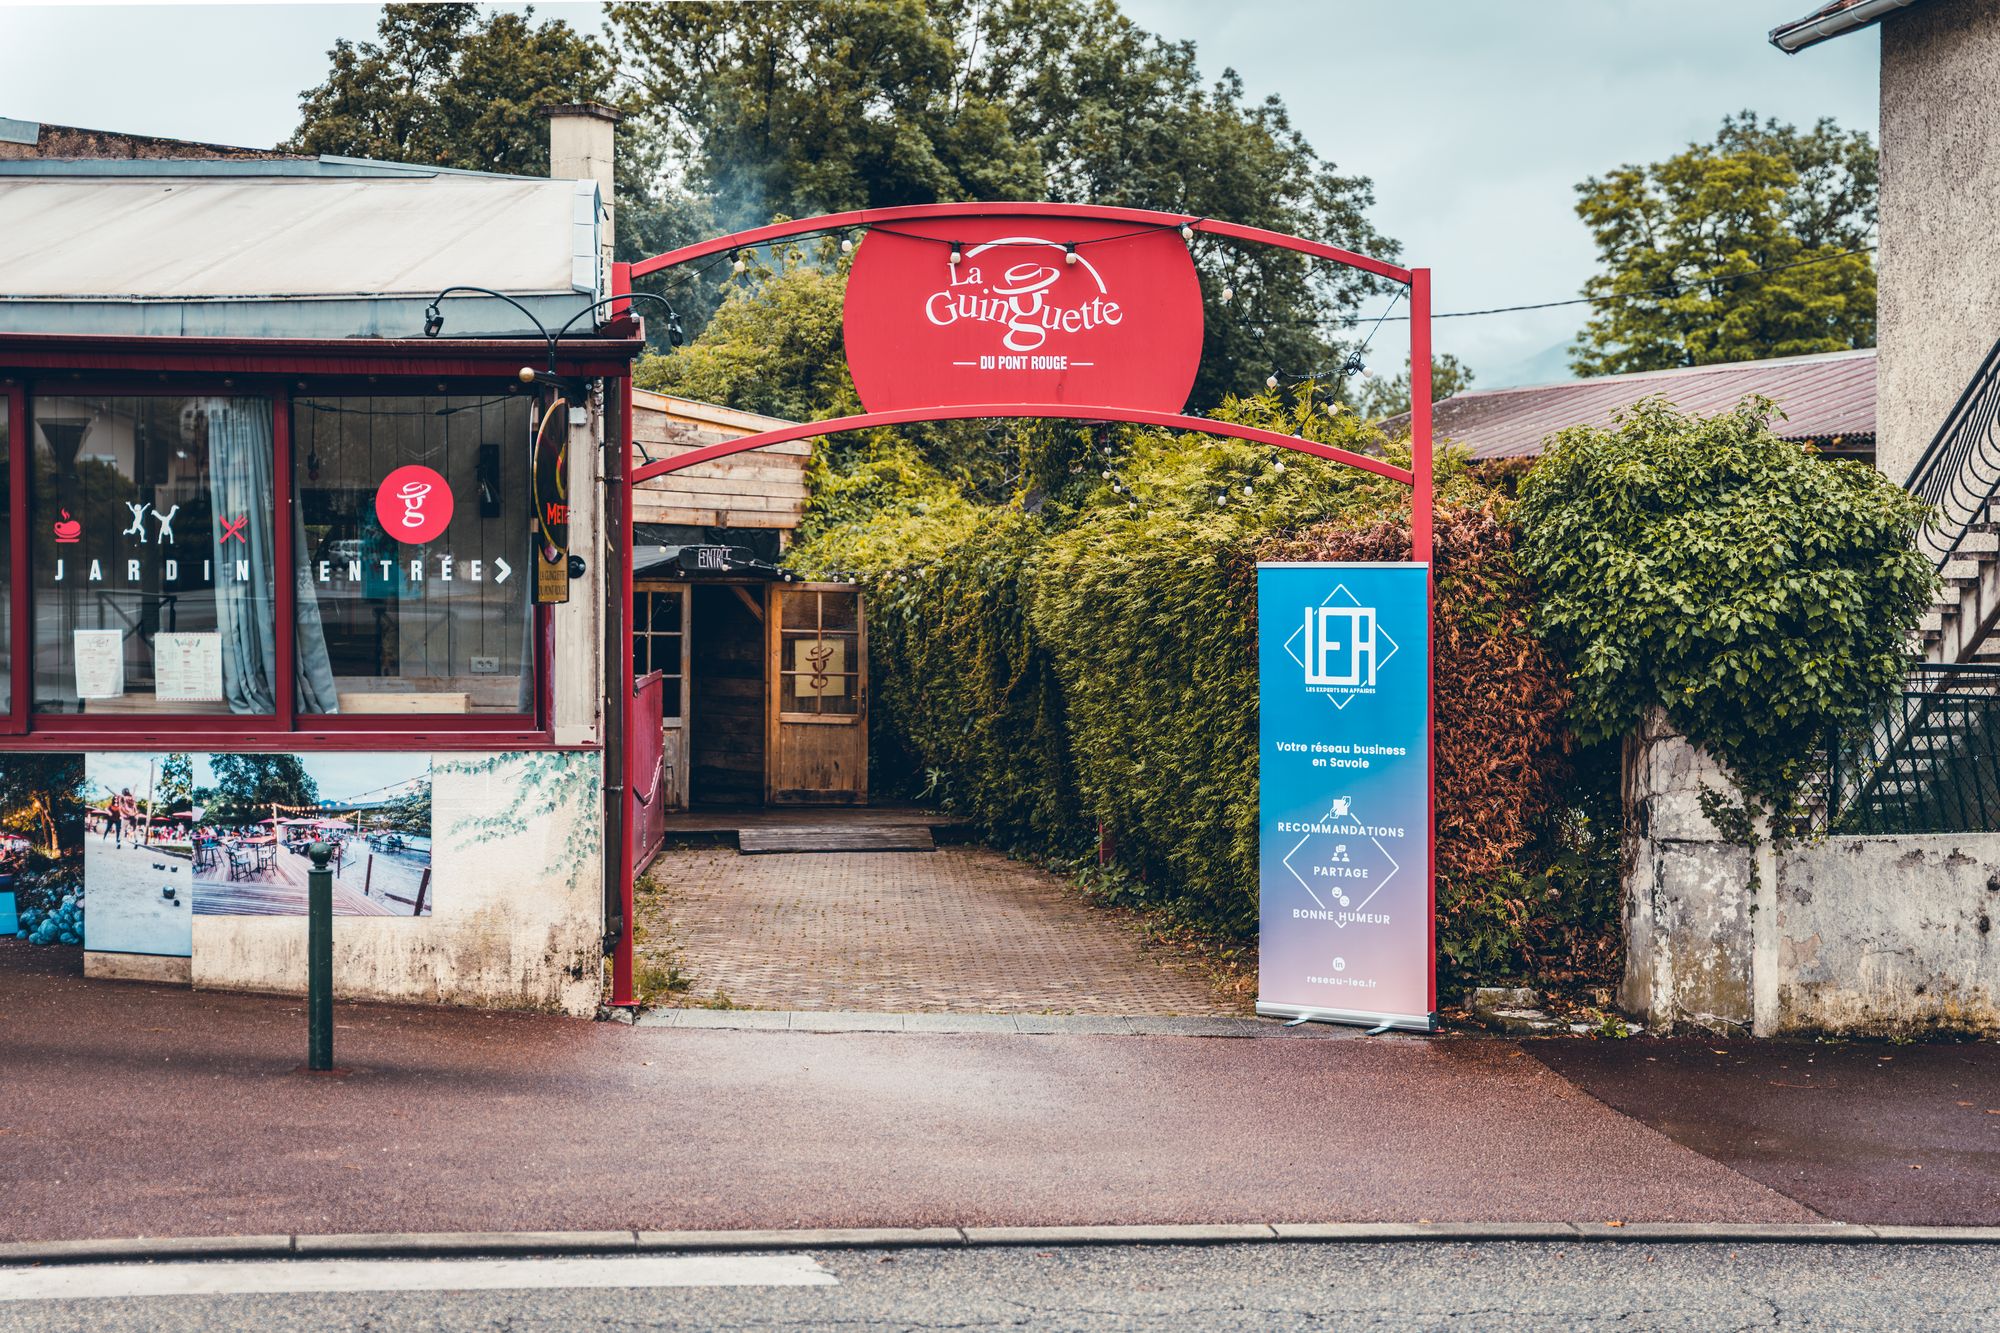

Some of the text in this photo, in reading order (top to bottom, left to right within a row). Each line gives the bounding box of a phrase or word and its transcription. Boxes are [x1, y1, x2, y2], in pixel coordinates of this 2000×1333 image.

[946, 262, 983, 286] La
[925, 287, 1123, 352] Guinguette
[980, 356, 1068, 370] DU PONT ROUGE
[55, 556, 481, 581] JARDIN ENTRÉE
[1316, 686, 1340, 694] EXPERTS
[1349, 687, 1376, 695] AFFAIRES
[1276, 741, 1406, 756] Votre réseau business
[1312, 758, 1370, 769] en Savoie
[1277, 822, 1405, 838] RECOMMANDATIONS
[1313, 866, 1369, 879] PARTAGE
[1292, 909, 1391, 925] BONNE HUMEUR
[1306, 975, 1377, 988] reseau-lea.fr
